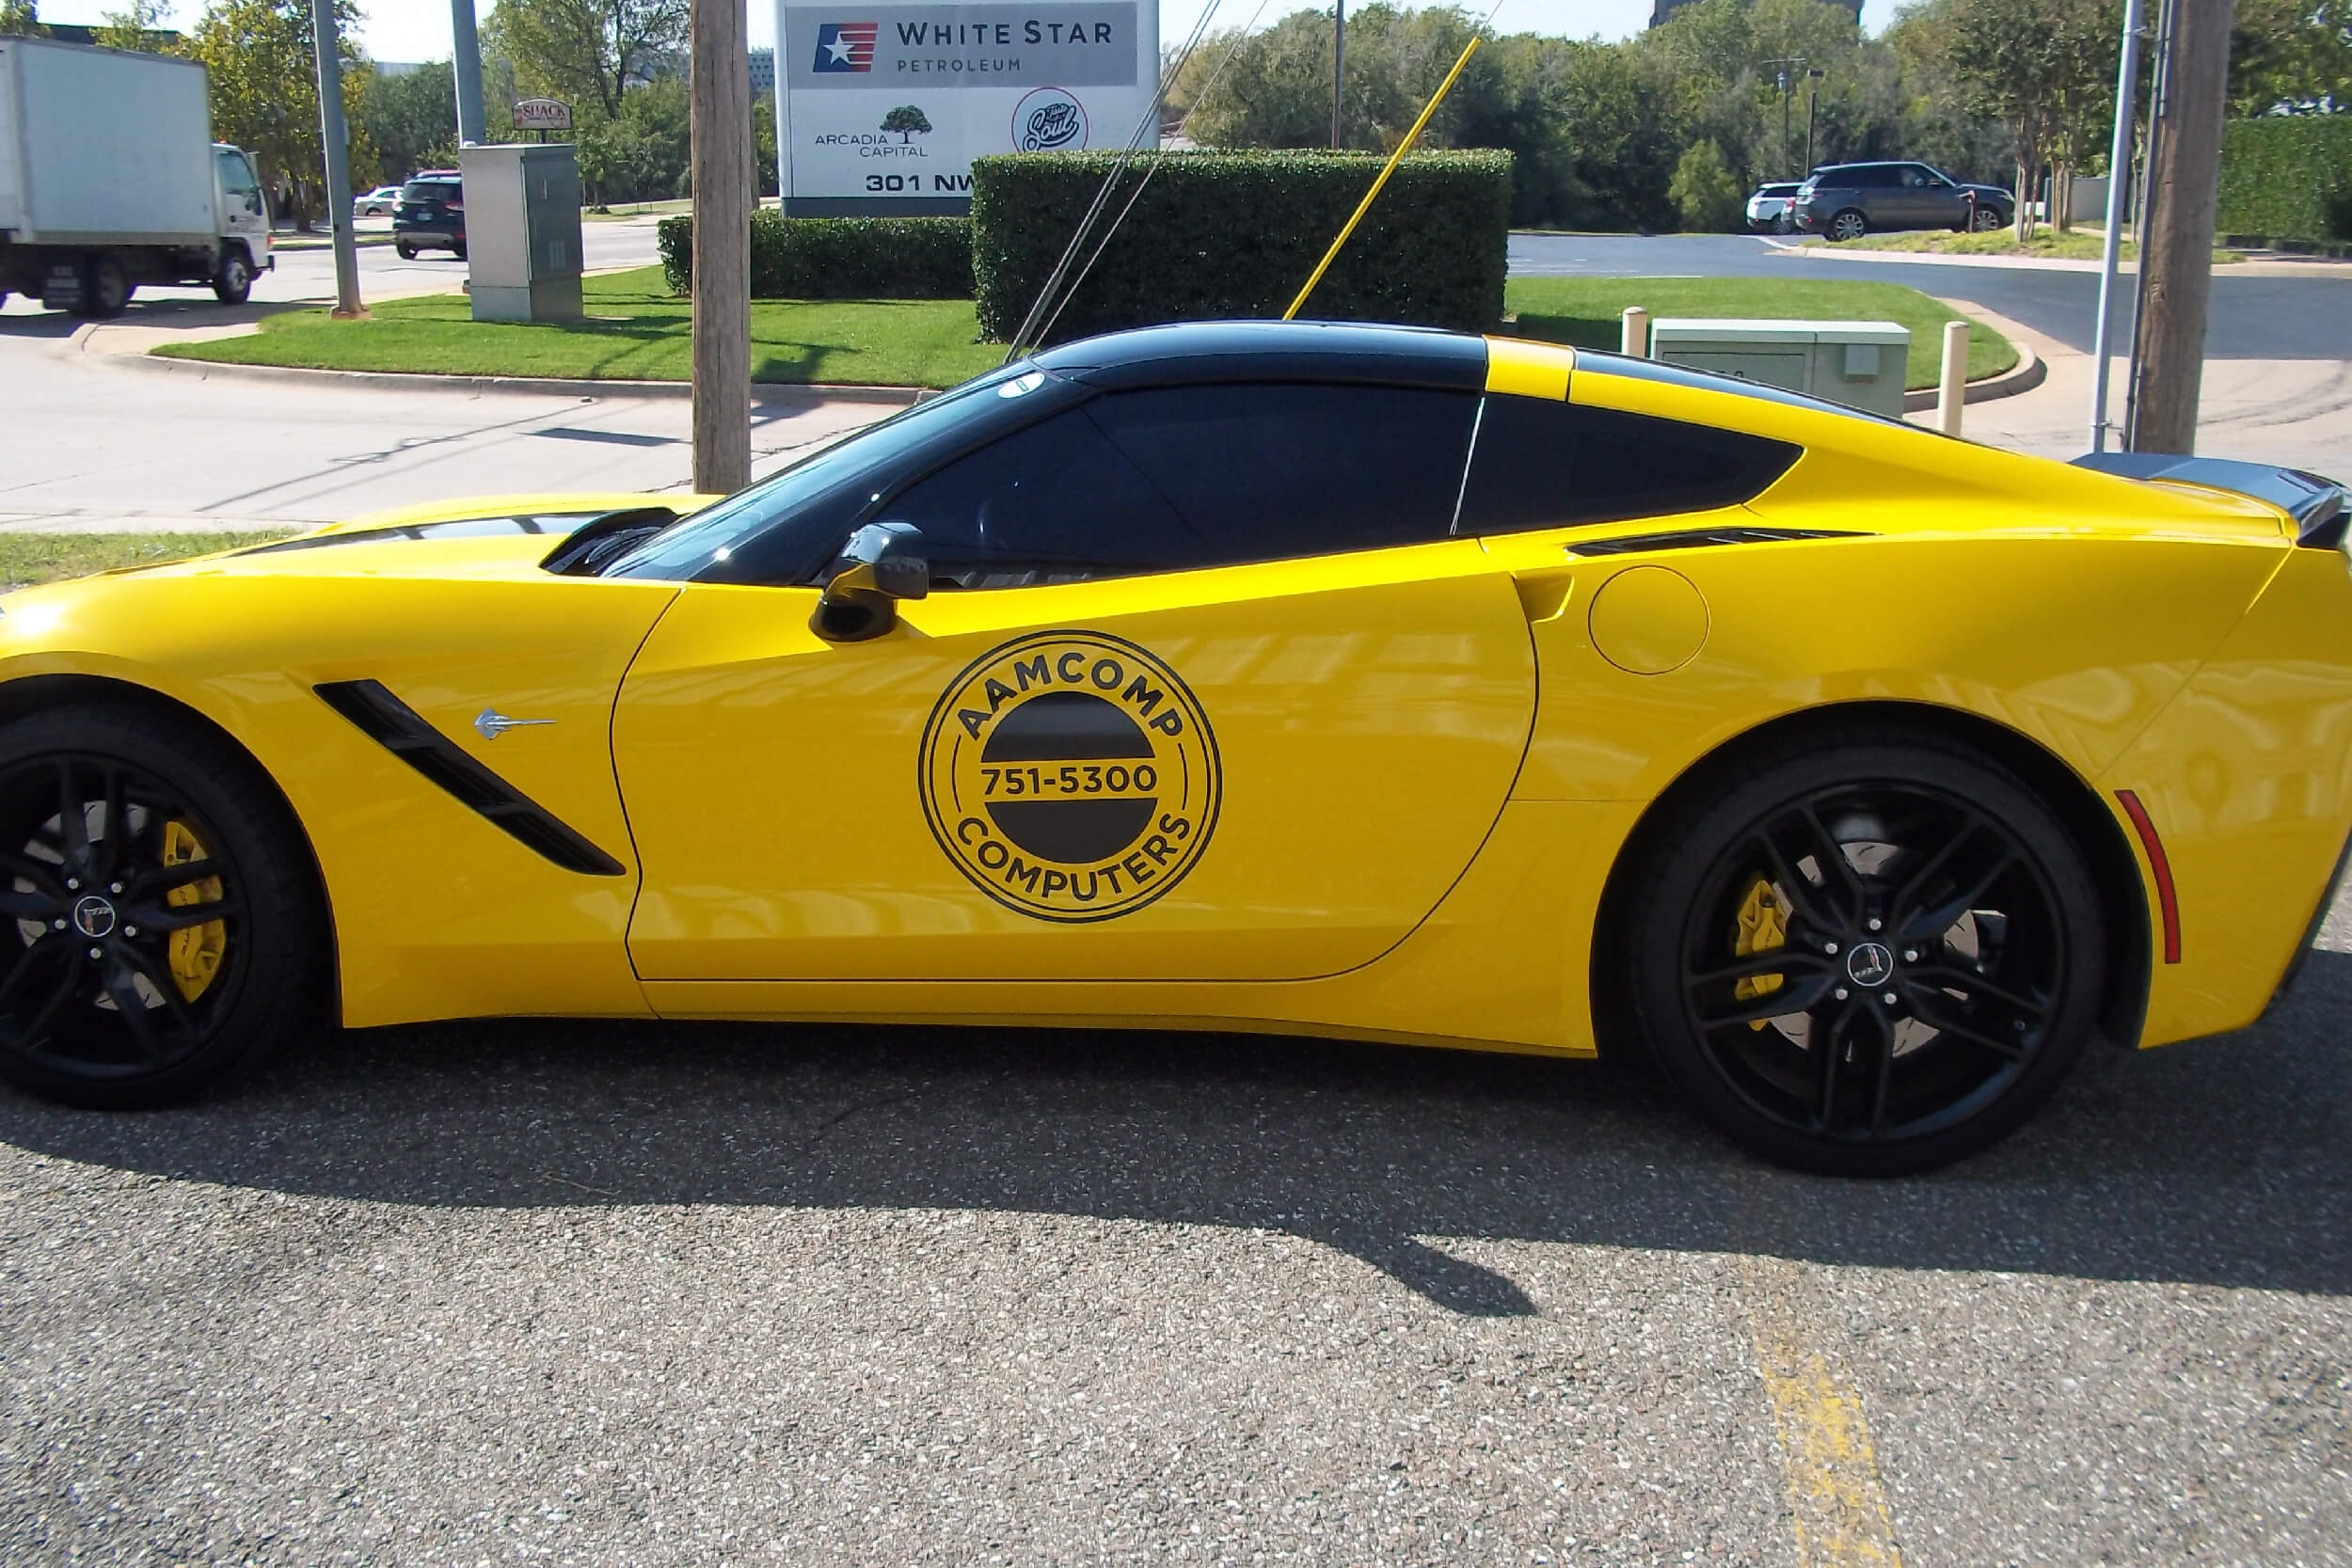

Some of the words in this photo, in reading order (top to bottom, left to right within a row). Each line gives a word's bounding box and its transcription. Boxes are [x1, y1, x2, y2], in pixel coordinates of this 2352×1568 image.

[897, 22, 1010, 45] WHITE
[1024, 20, 1112, 44] STAR
[898, 58, 1021, 72] PETROLEUM
[815, 135, 888, 145] ARCADIA
[859, 146, 929, 158] CAPITAL
[866, 174, 920, 191] 301
[957, 652, 1183, 741] AAMCOMP
[980, 765, 1157, 795] 751-5300
[957, 813, 1190, 902] COMPUTERS
